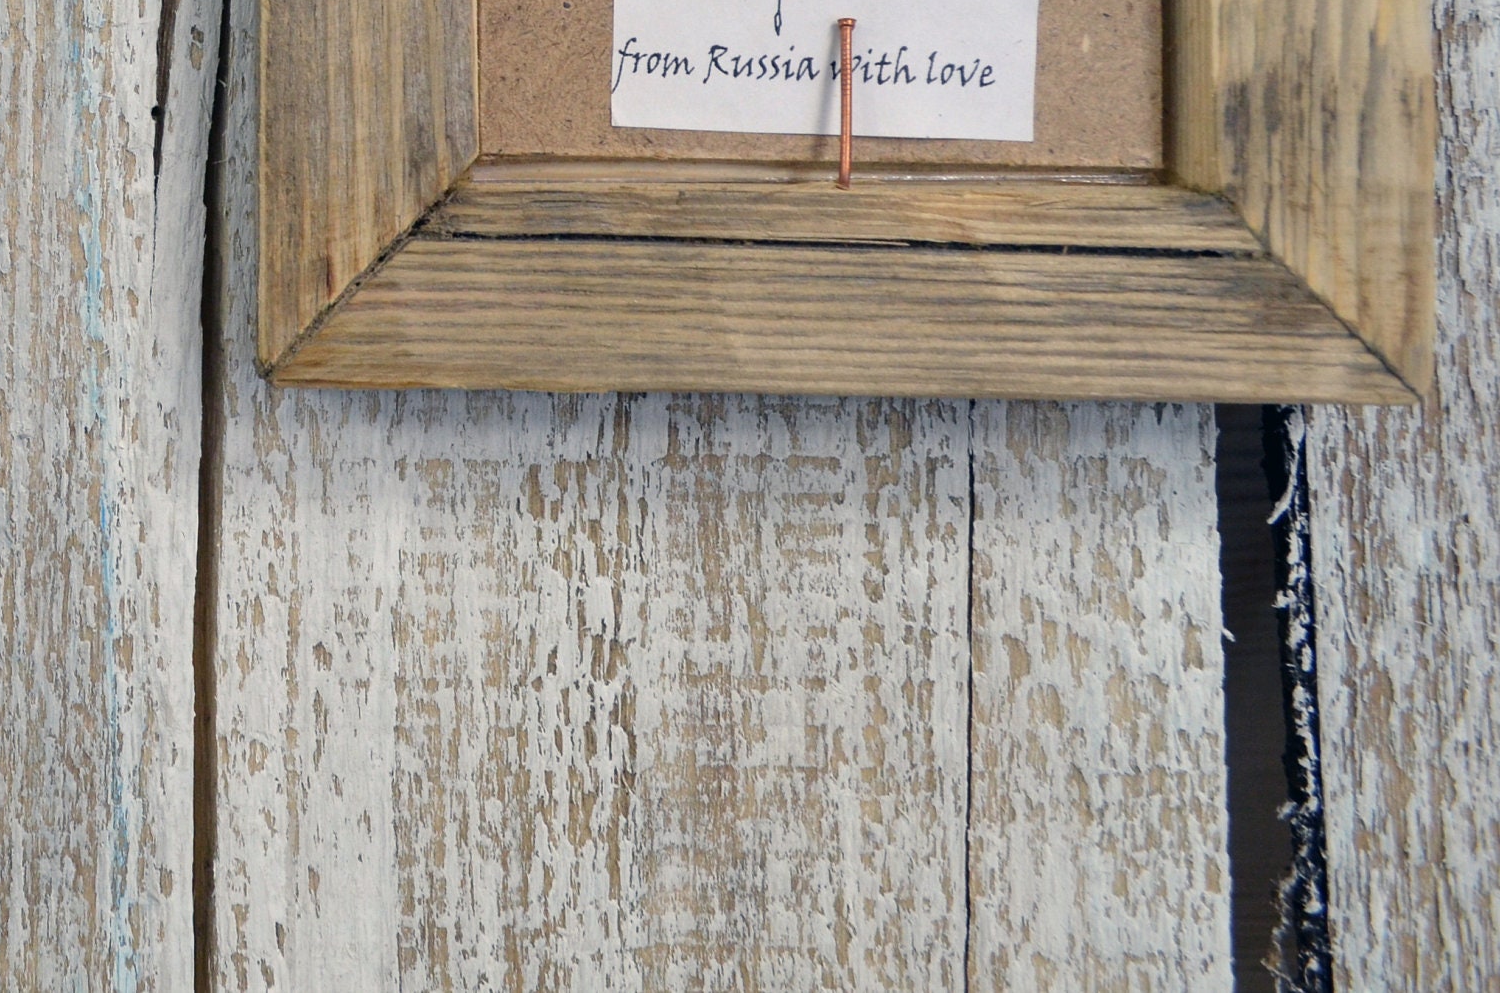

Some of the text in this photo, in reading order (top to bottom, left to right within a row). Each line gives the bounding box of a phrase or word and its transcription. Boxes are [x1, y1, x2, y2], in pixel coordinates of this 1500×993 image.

[610, 37, 695, 94] from
[702, 43, 821, 85] Russia
[926, 50, 997, 89] love
